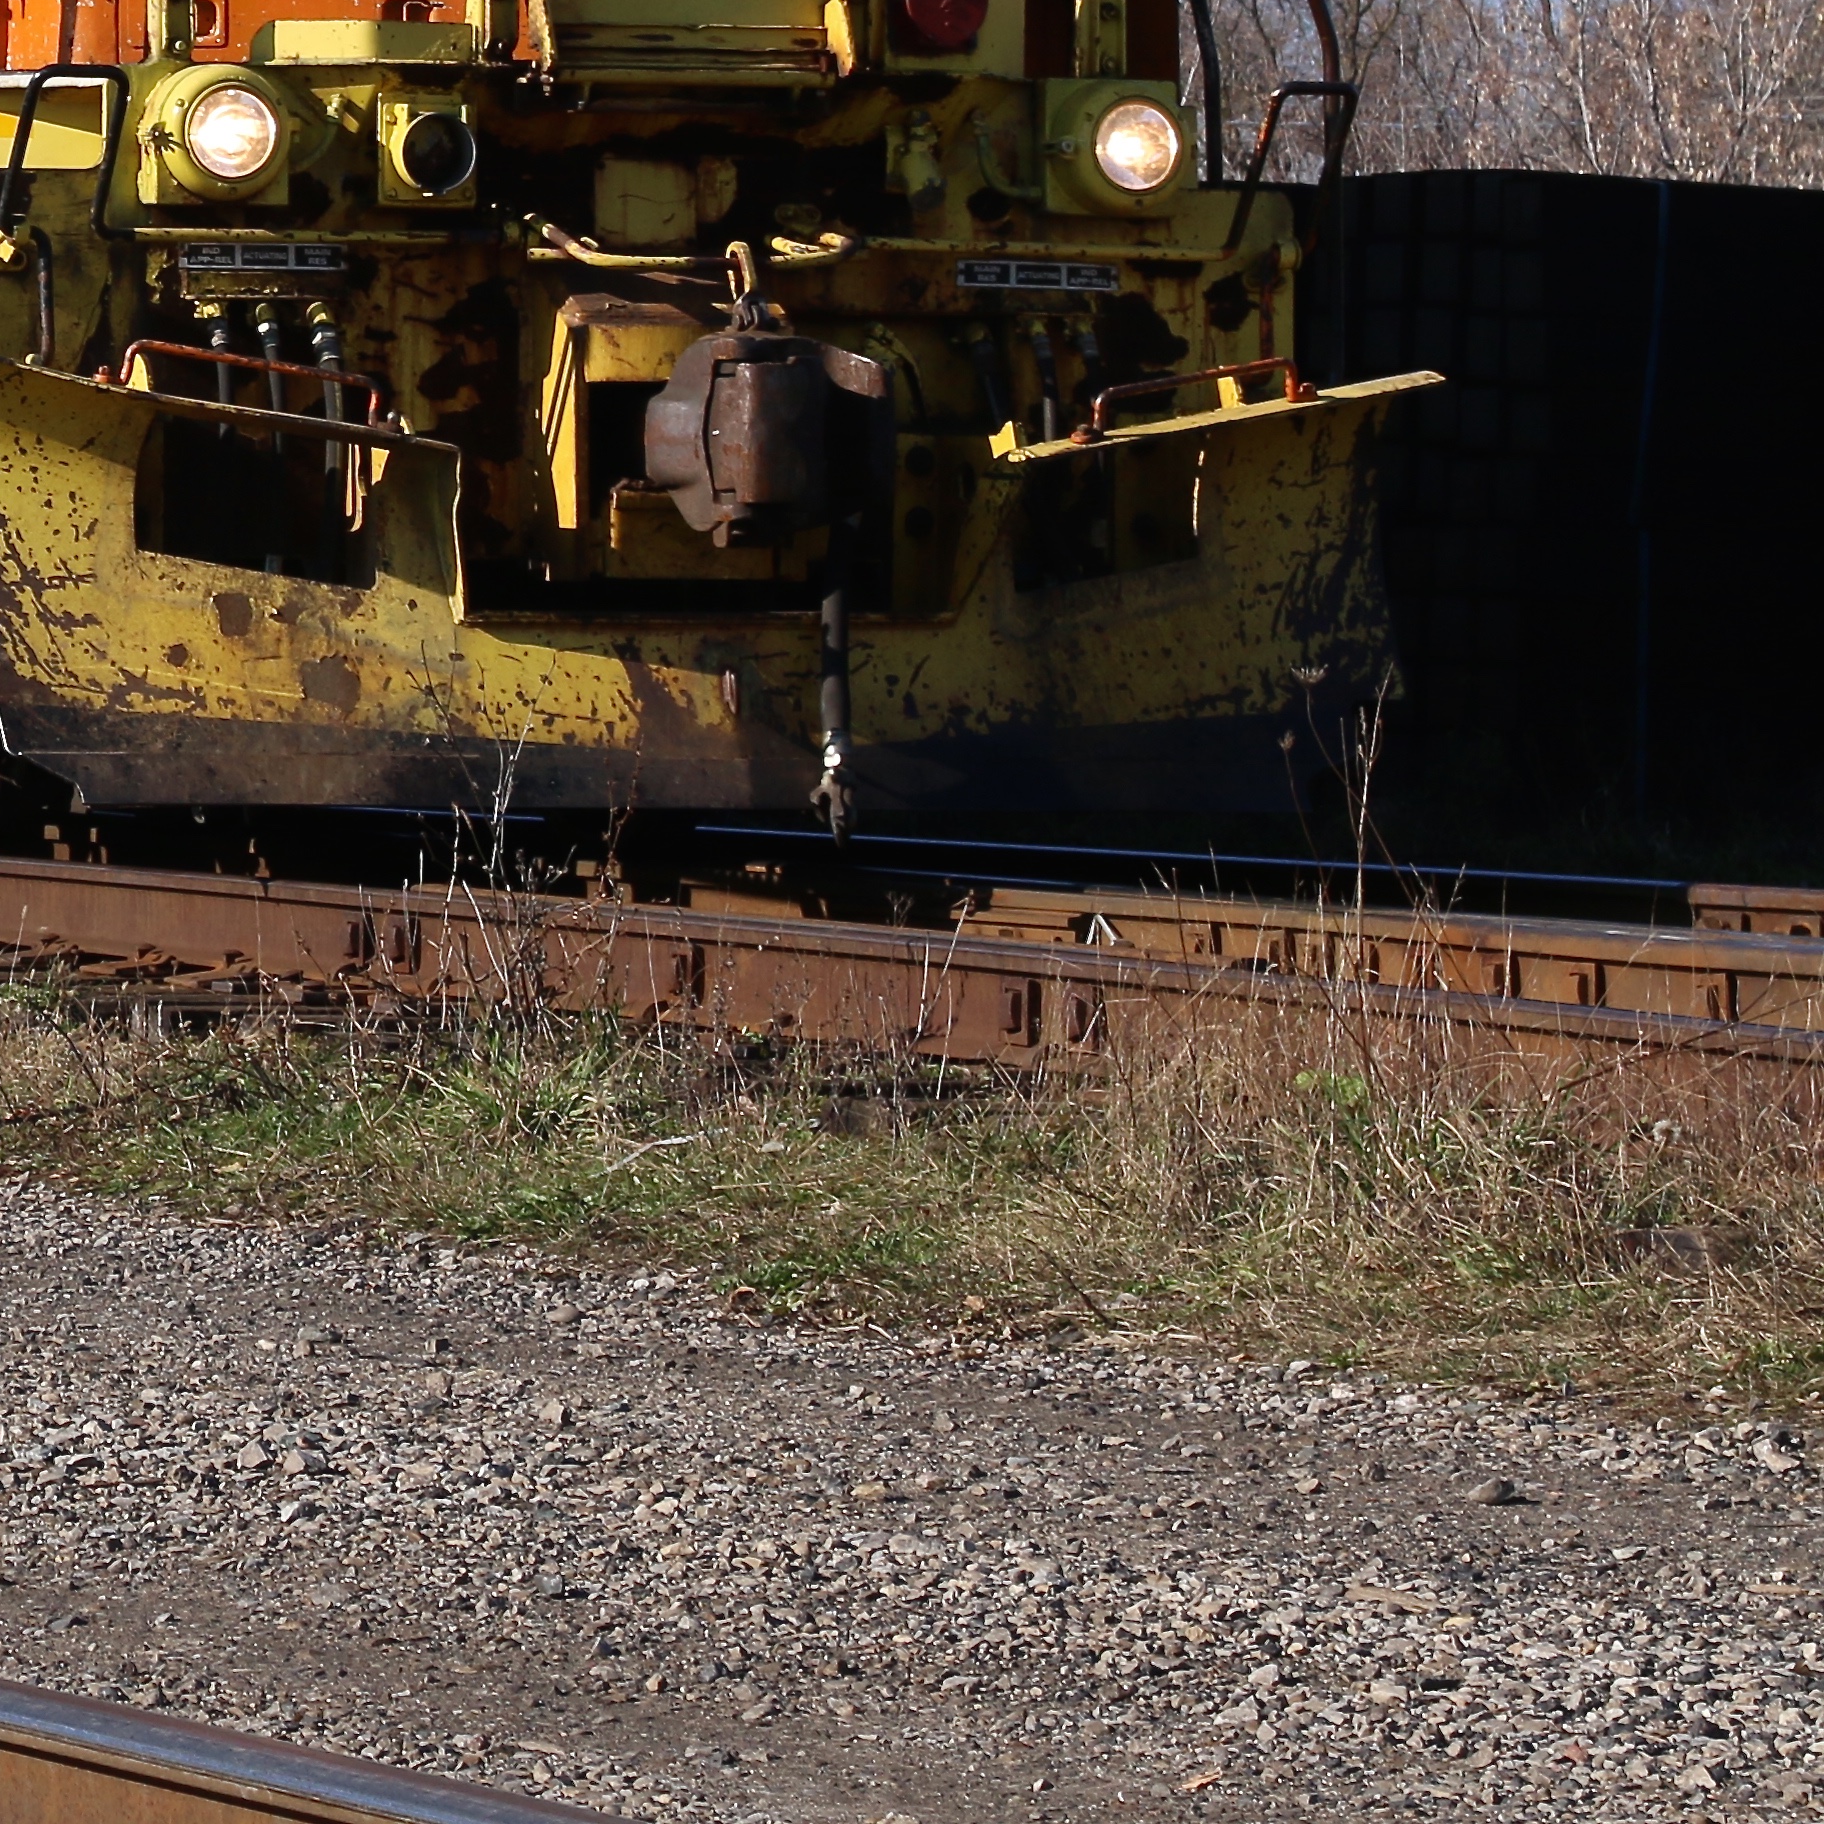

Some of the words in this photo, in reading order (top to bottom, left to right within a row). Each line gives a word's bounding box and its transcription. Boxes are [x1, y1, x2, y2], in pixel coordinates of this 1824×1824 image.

[243, 252, 287, 260] ACTUATING
[304, 248, 331, 256] MAIN
[307, 257, 327, 265] RES
